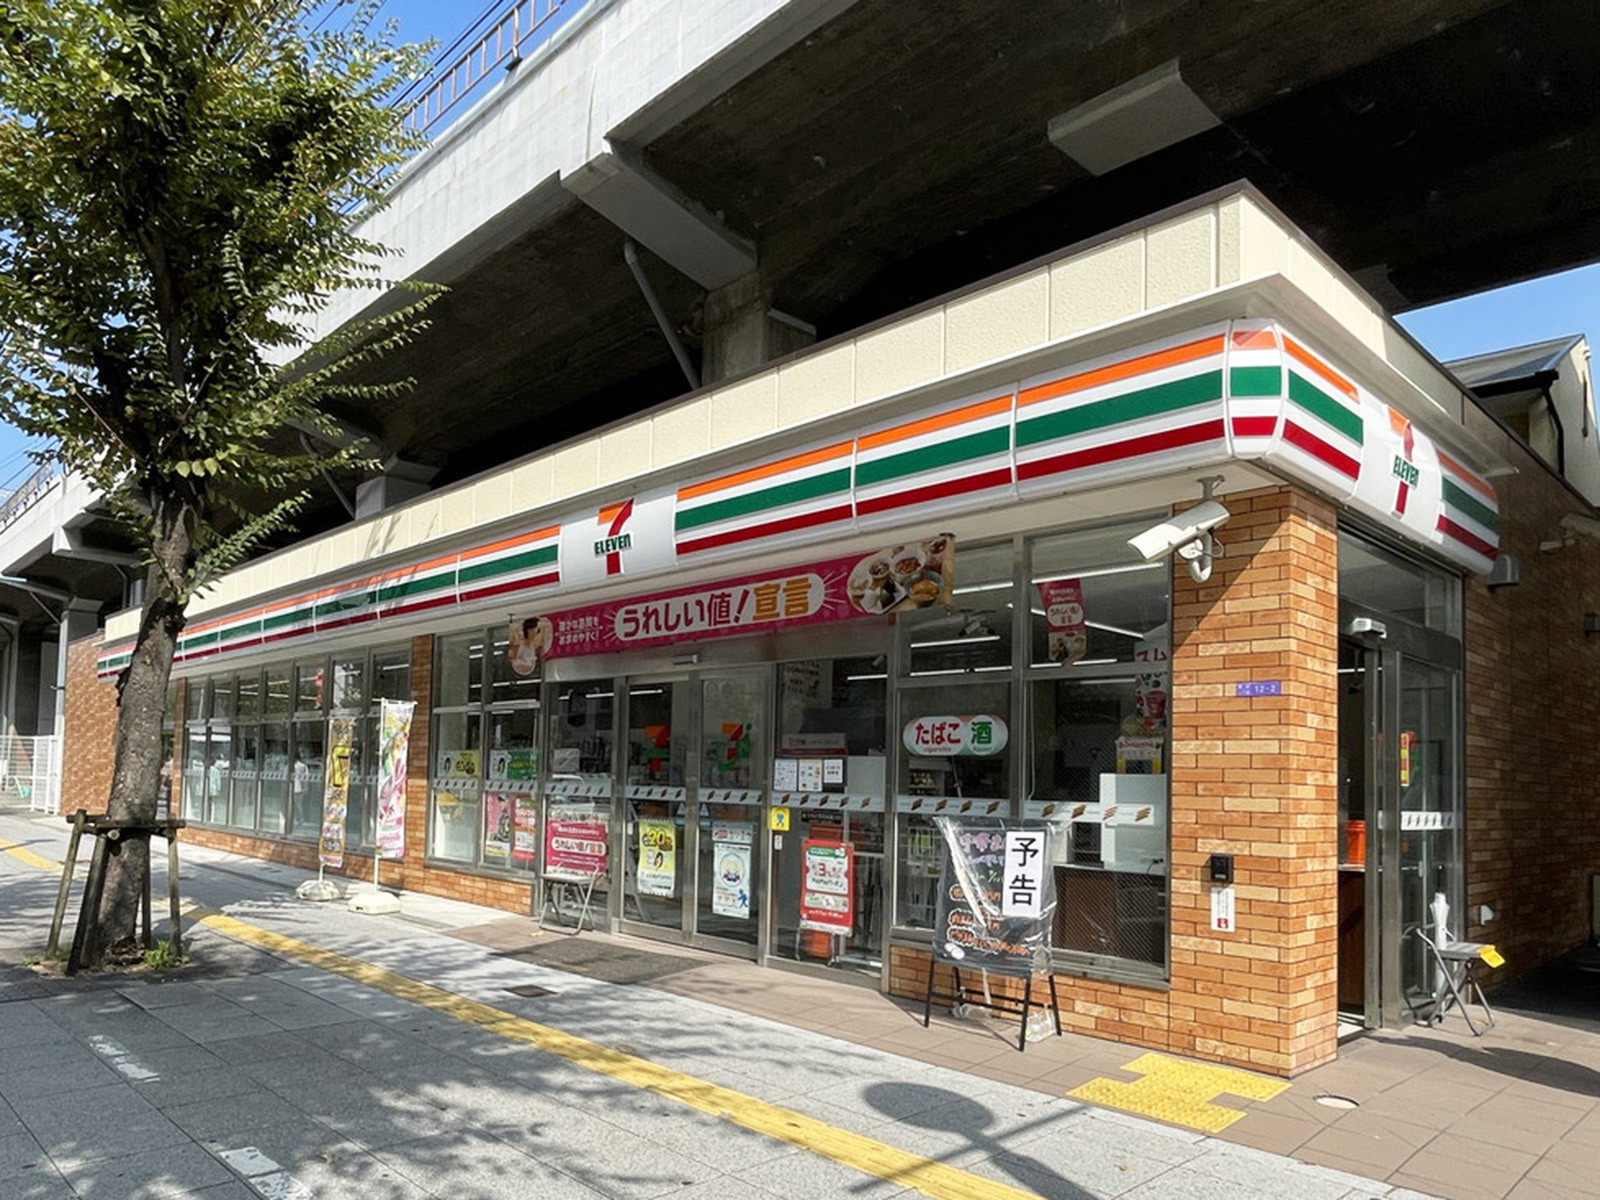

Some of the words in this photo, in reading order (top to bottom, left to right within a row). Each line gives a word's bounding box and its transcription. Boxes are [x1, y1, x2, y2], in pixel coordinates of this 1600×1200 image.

[1388, 405, 1414, 514] 7
[597, 497, 635, 575] 7
[915, 721, 961, 745] たばこ
[970, 721, 992, 744] 酒
[1009, 836, 1039, 907] 予告
